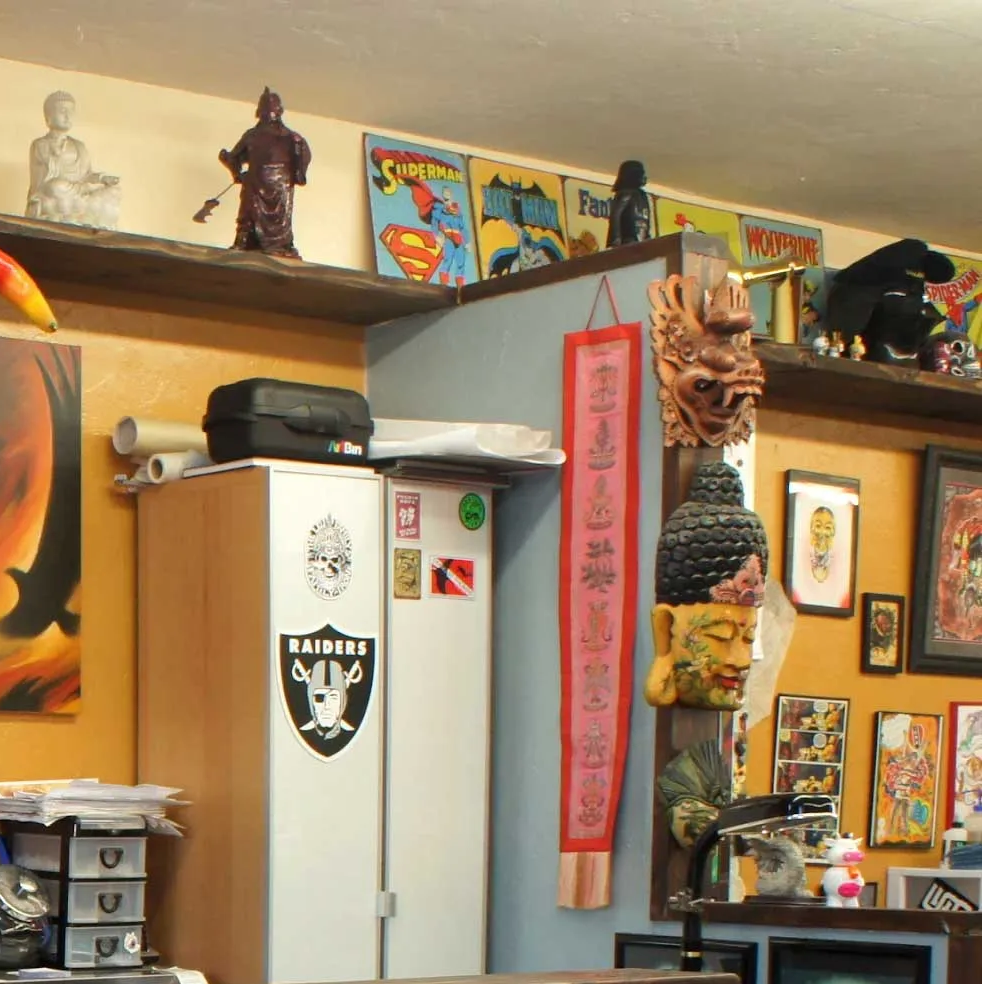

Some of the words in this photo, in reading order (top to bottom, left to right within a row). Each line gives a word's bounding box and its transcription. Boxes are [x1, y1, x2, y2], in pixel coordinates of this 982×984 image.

[380, 157, 464, 195] SUPERMAN
[745, 223, 821, 267] WOLVERINE
[328, 440, 363, 456] ArtBin
[289, 637, 367, 656] RAIDERS
